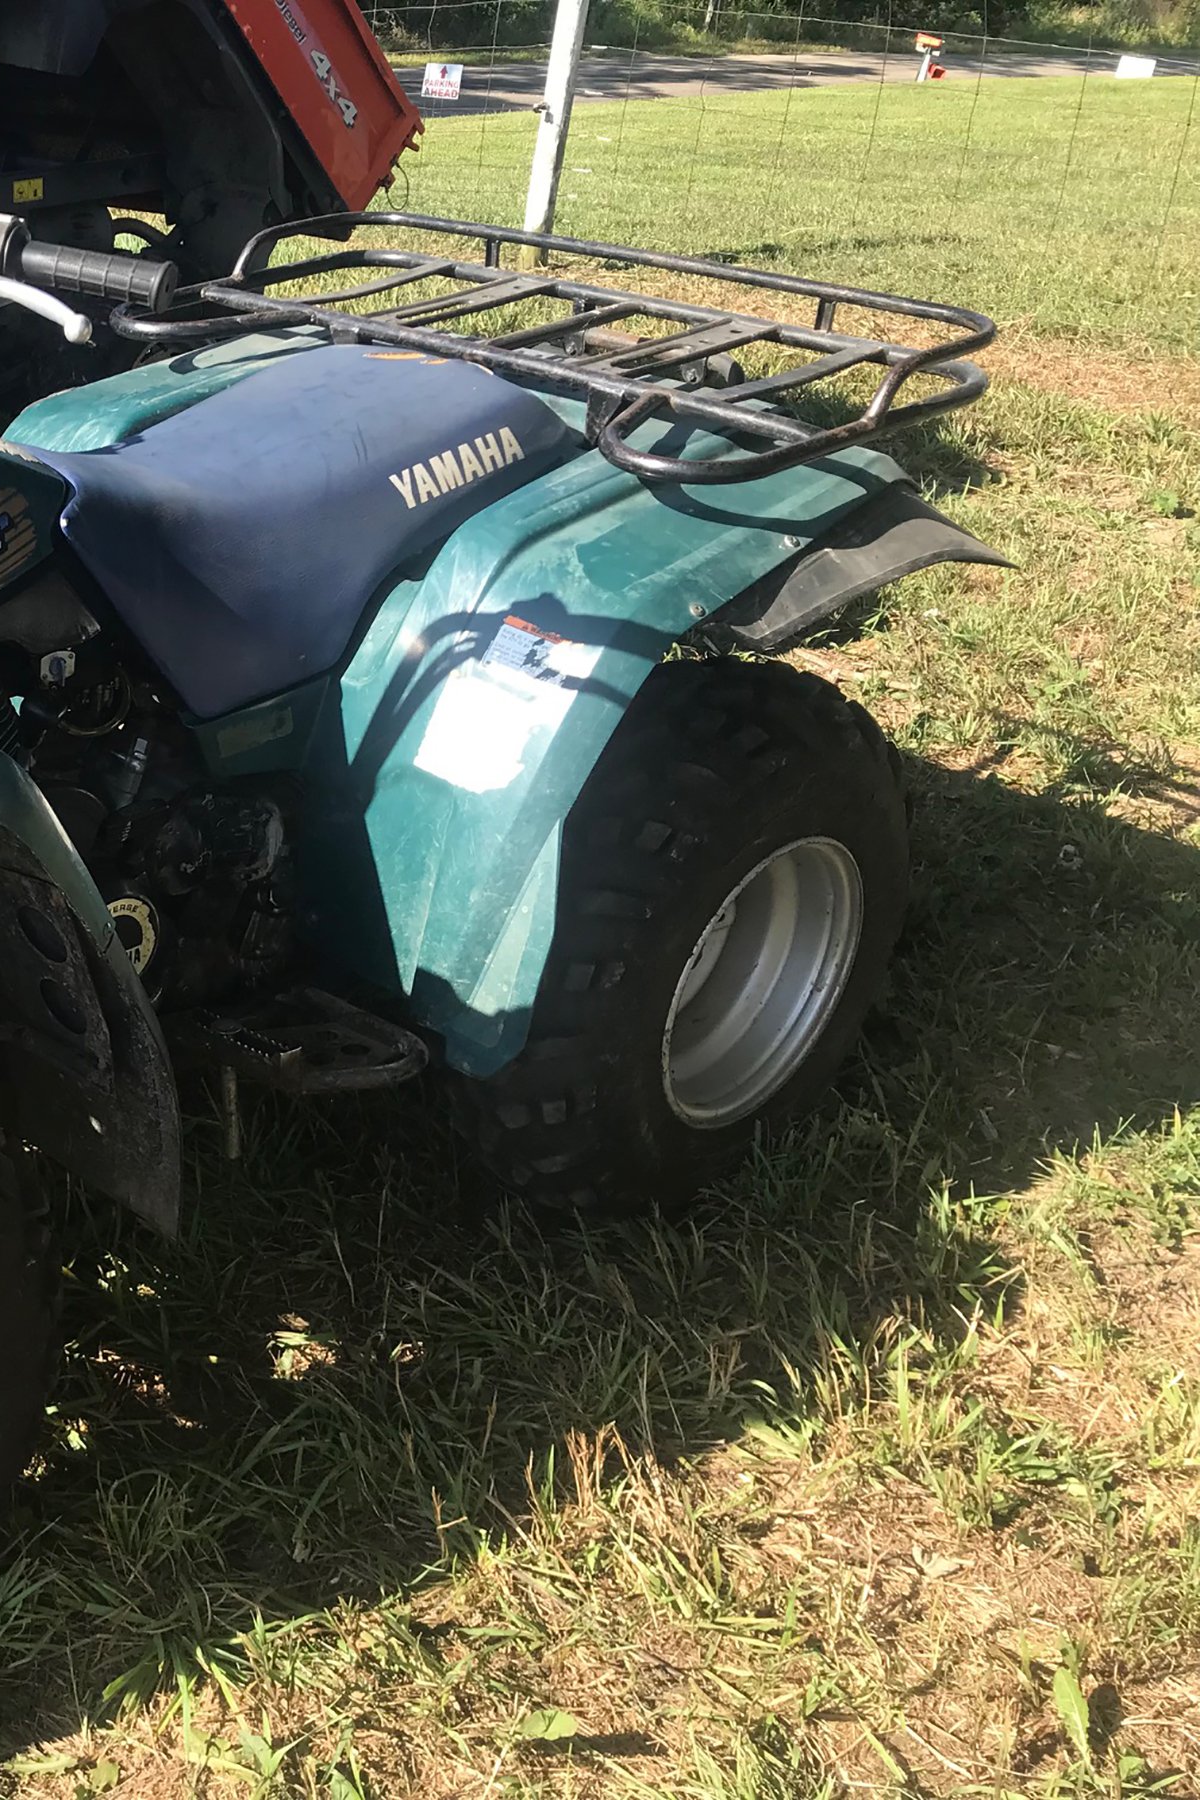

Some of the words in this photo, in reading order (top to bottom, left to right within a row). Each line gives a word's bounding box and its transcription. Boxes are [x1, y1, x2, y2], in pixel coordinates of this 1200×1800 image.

[424, 79, 459, 88] PARKING
[423, 87, 458, 98] AHEAD
[388, 426, 525, 509] YAMAHA
[109, 903, 139, 913] ERSE
